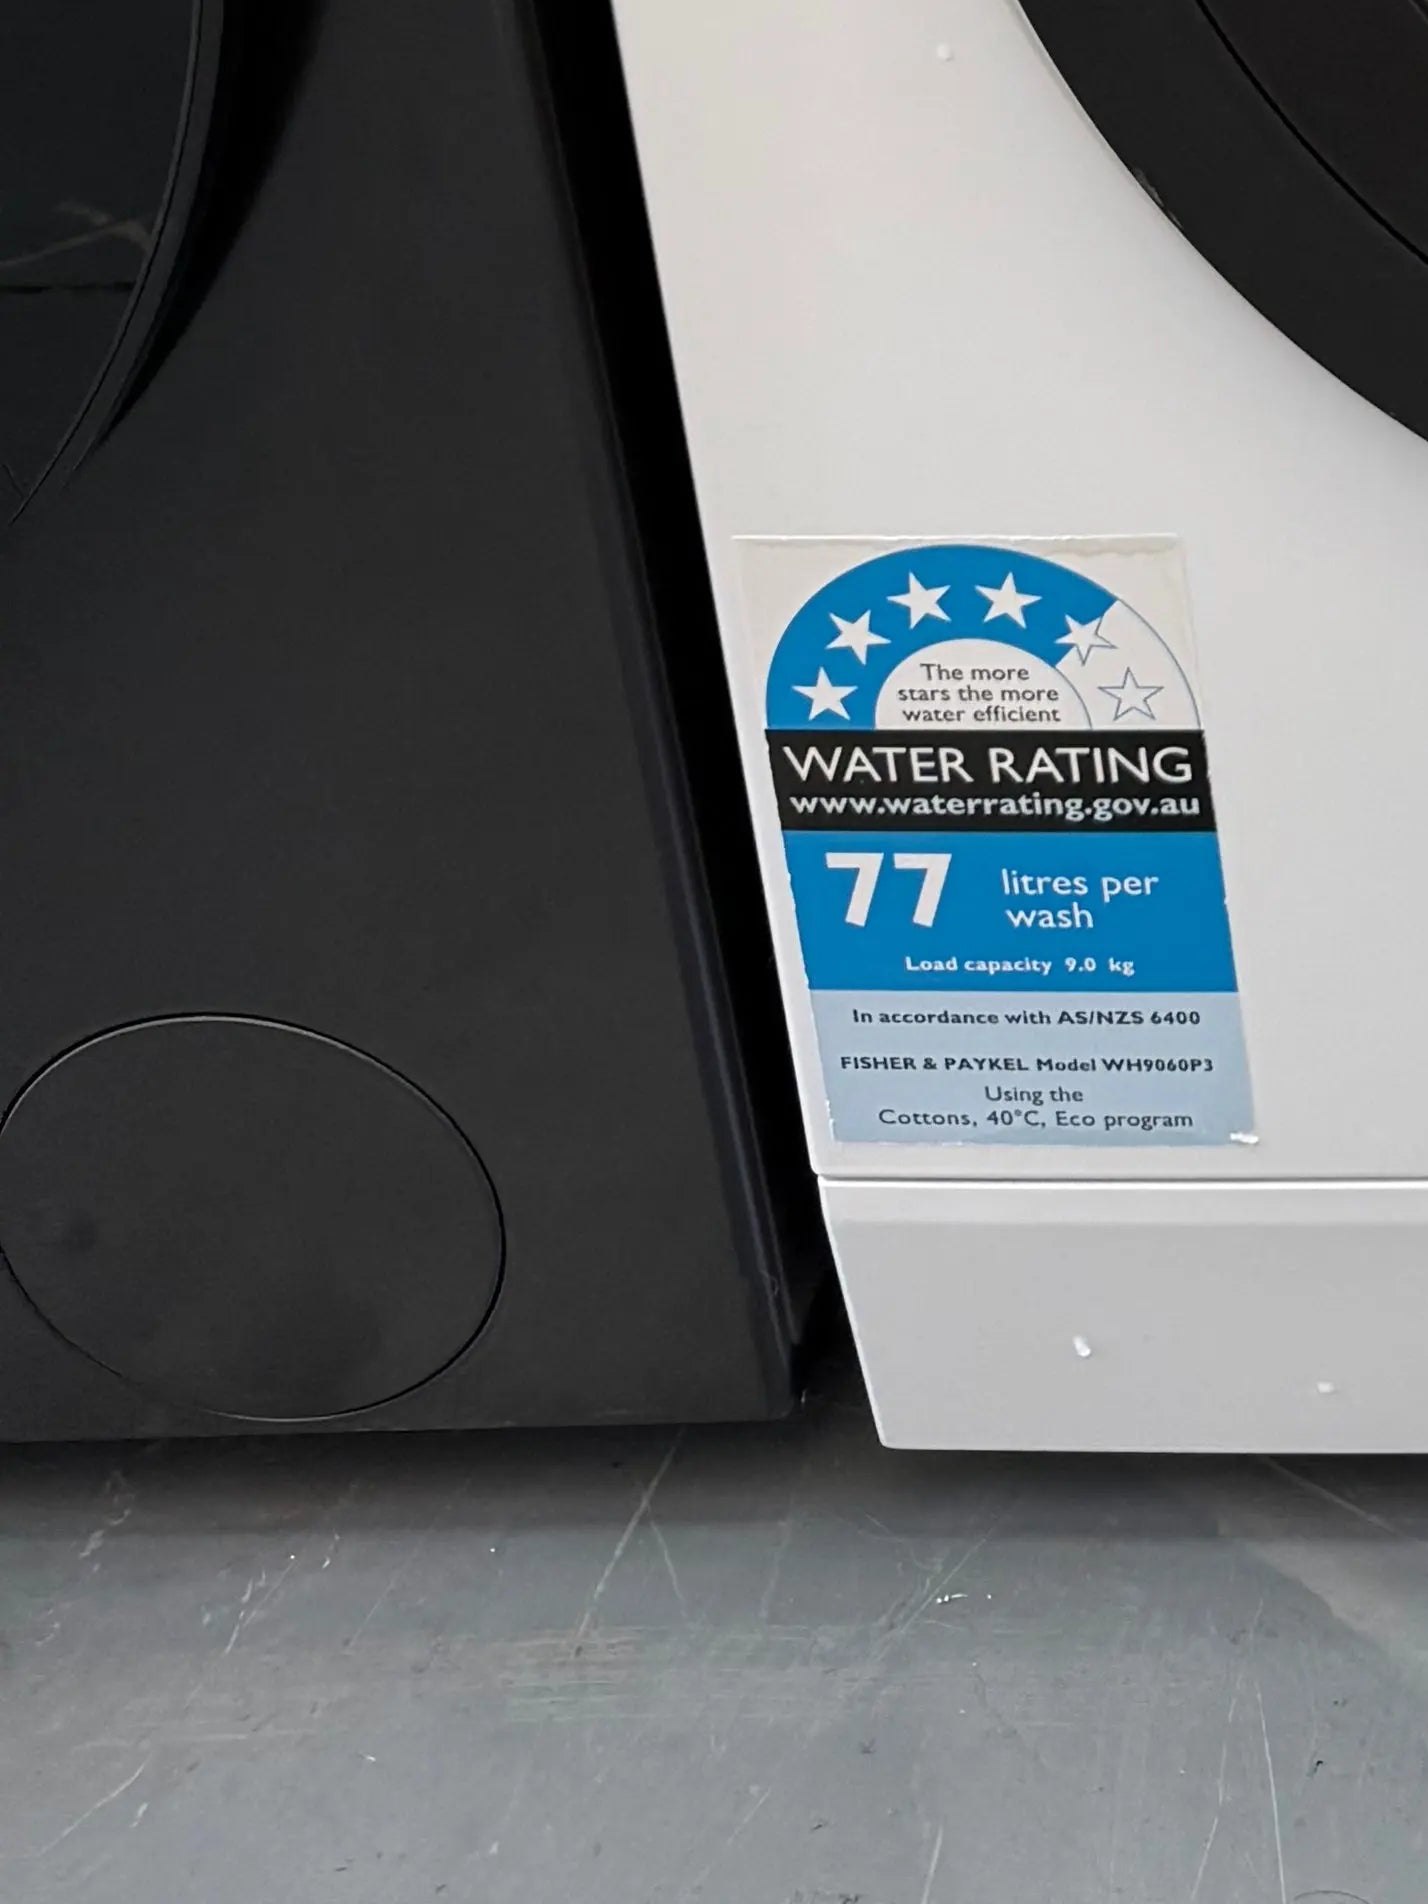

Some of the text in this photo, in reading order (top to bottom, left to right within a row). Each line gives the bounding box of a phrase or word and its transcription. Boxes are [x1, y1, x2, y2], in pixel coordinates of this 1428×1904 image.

[920, 664, 1029, 680] The more
[898, 685, 1058, 701] stars the more
[903, 705, 1060, 722] water efficient
[783, 747, 1192, 783] WATER RATING
[790, 792, 1199, 821] www.waterrating.gov.au
[826, 853, 952, 927] 77
[1002, 869, 1158, 902] litres per
[1006, 902, 1093, 928] wash
[906, 957, 1134, 976] Load capacity 9.0 kg
[853, 1010, 1200, 1024] In accordance with AS/NZS 6400
[841, 1057, 1212, 1072] FISHER & PAYKEL Model WH9060P3
[985, 1086, 1083, 1106] Using the
[879, 1109, 977, 1126] Cottons,
[1056, 1111, 1095, 1126] Eco
[1104, 1116, 1192, 1131] program
